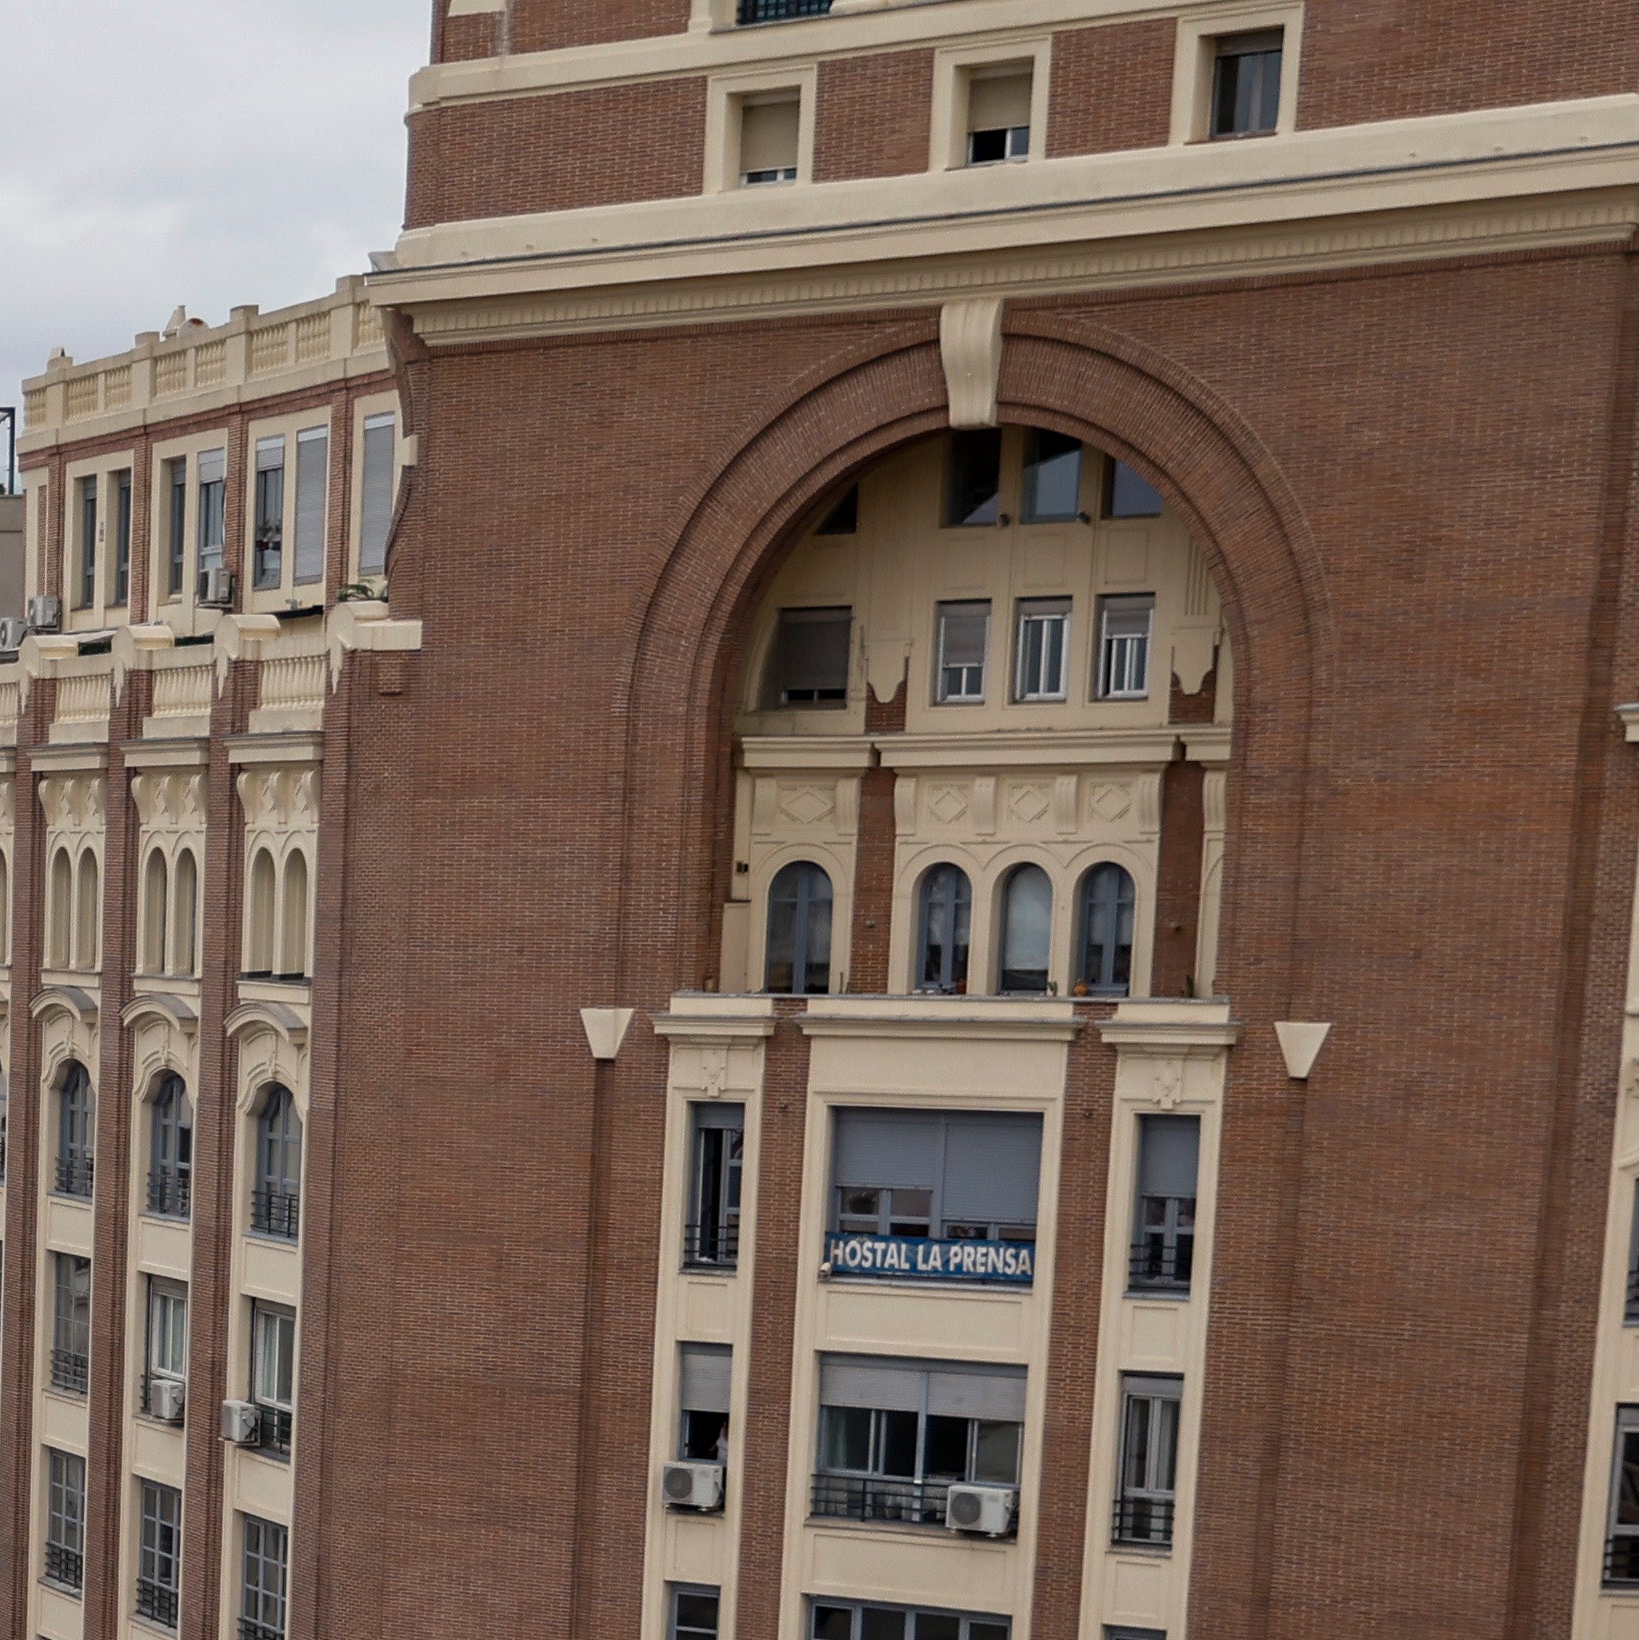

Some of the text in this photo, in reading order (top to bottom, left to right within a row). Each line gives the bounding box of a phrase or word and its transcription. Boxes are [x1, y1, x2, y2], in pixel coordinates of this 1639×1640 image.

[830, 1238, 1032, 1275] HOSTAL LA PRENSA
